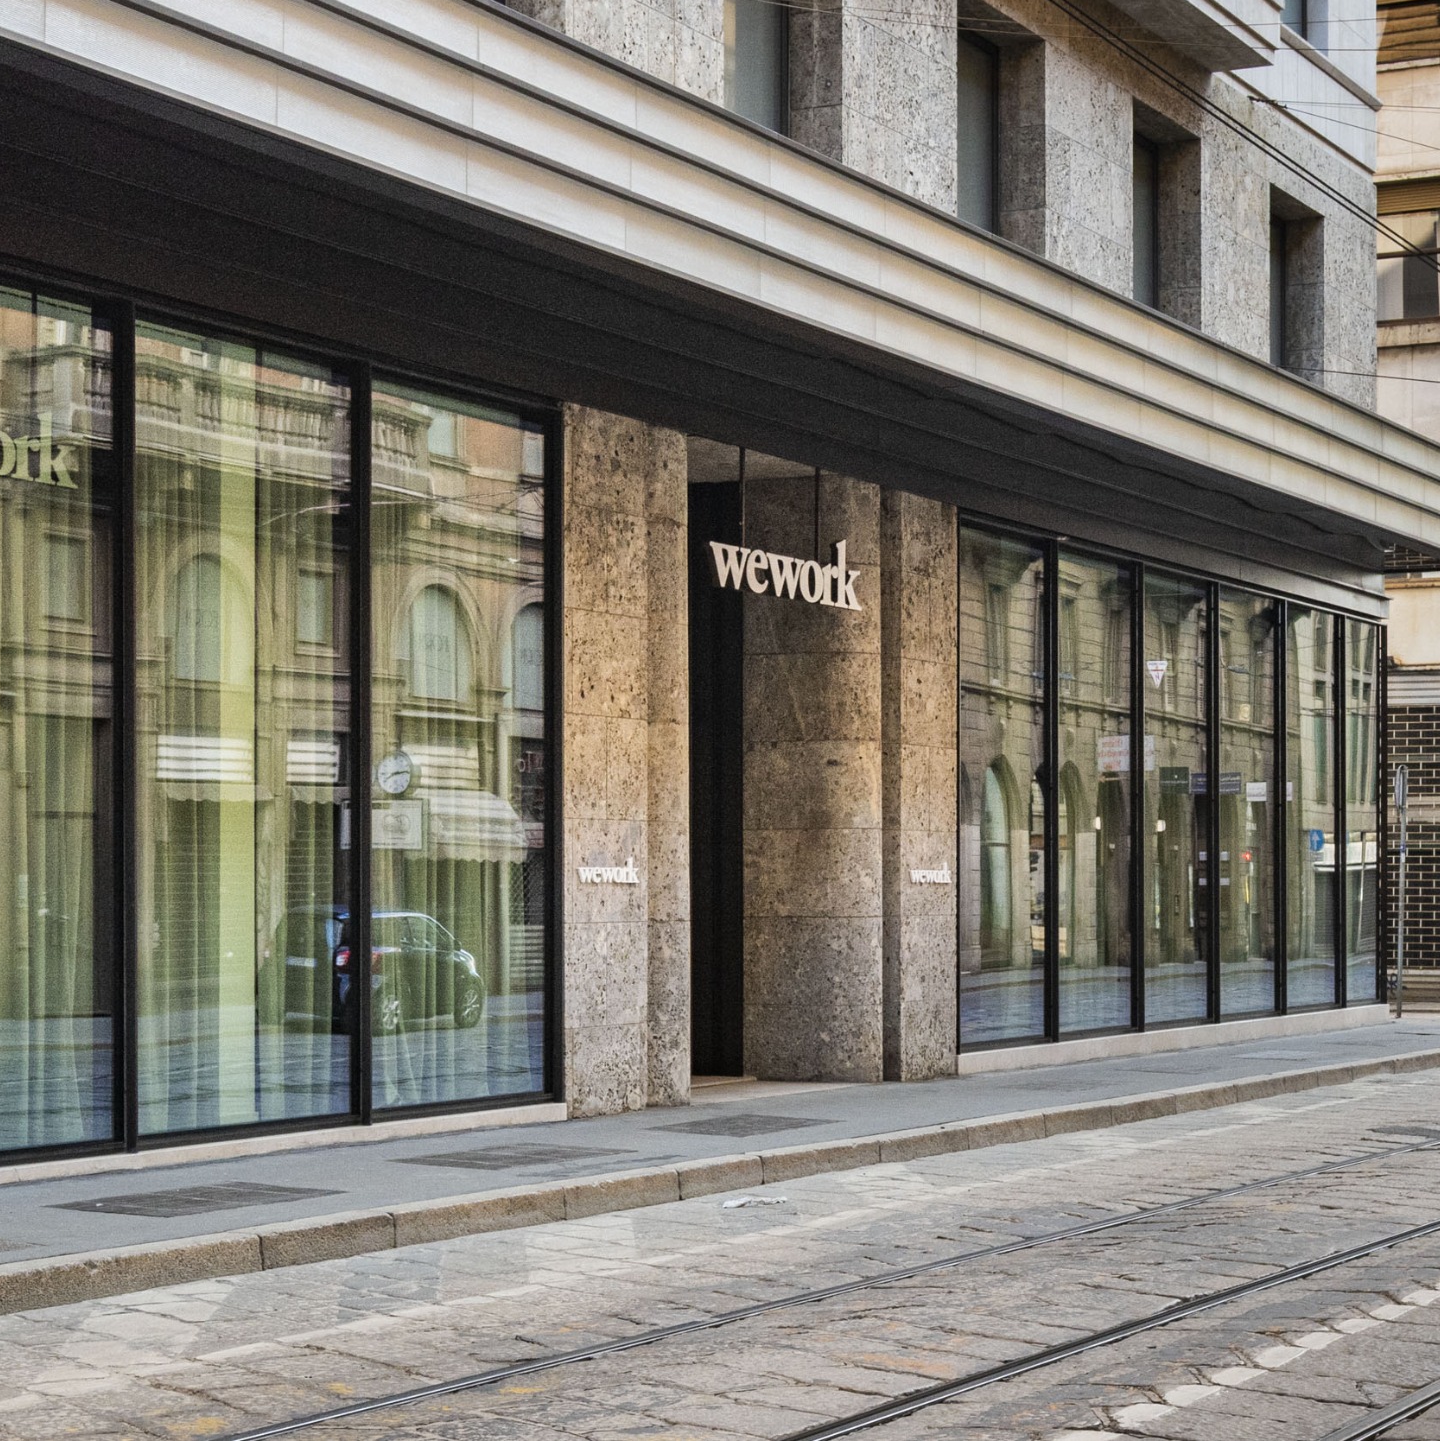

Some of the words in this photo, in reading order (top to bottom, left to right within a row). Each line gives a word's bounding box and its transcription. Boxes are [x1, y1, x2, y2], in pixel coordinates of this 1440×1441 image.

[709, 539, 863, 612] wework
[577, 858, 640, 885] wework
[909, 862, 952, 885] wework
